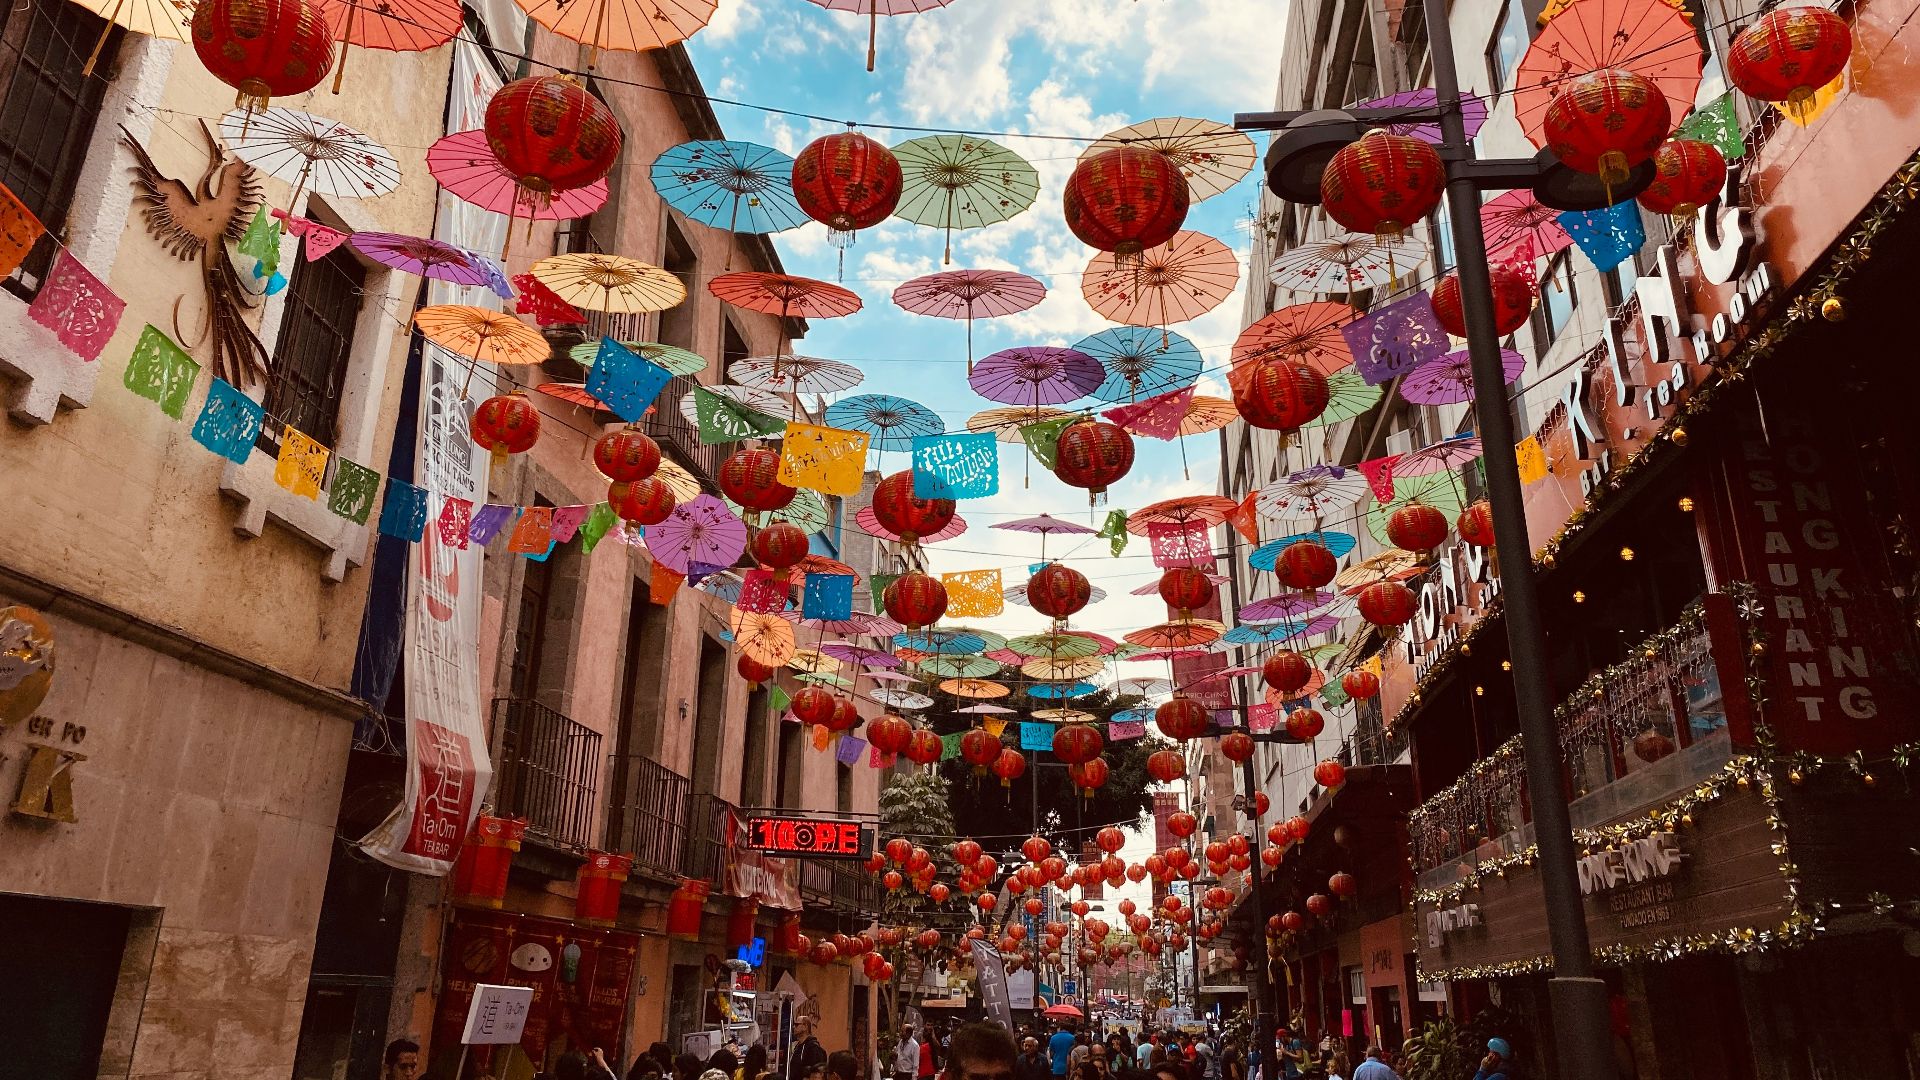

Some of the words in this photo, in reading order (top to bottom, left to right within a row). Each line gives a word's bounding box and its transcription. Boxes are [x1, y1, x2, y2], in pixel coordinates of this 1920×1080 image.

[1579, 449, 1609, 499] Bar
[1643, 362, 1687, 419] Tea
[1693, 262, 1773, 365] Room
[1811, 567, 1878, 719] KING
